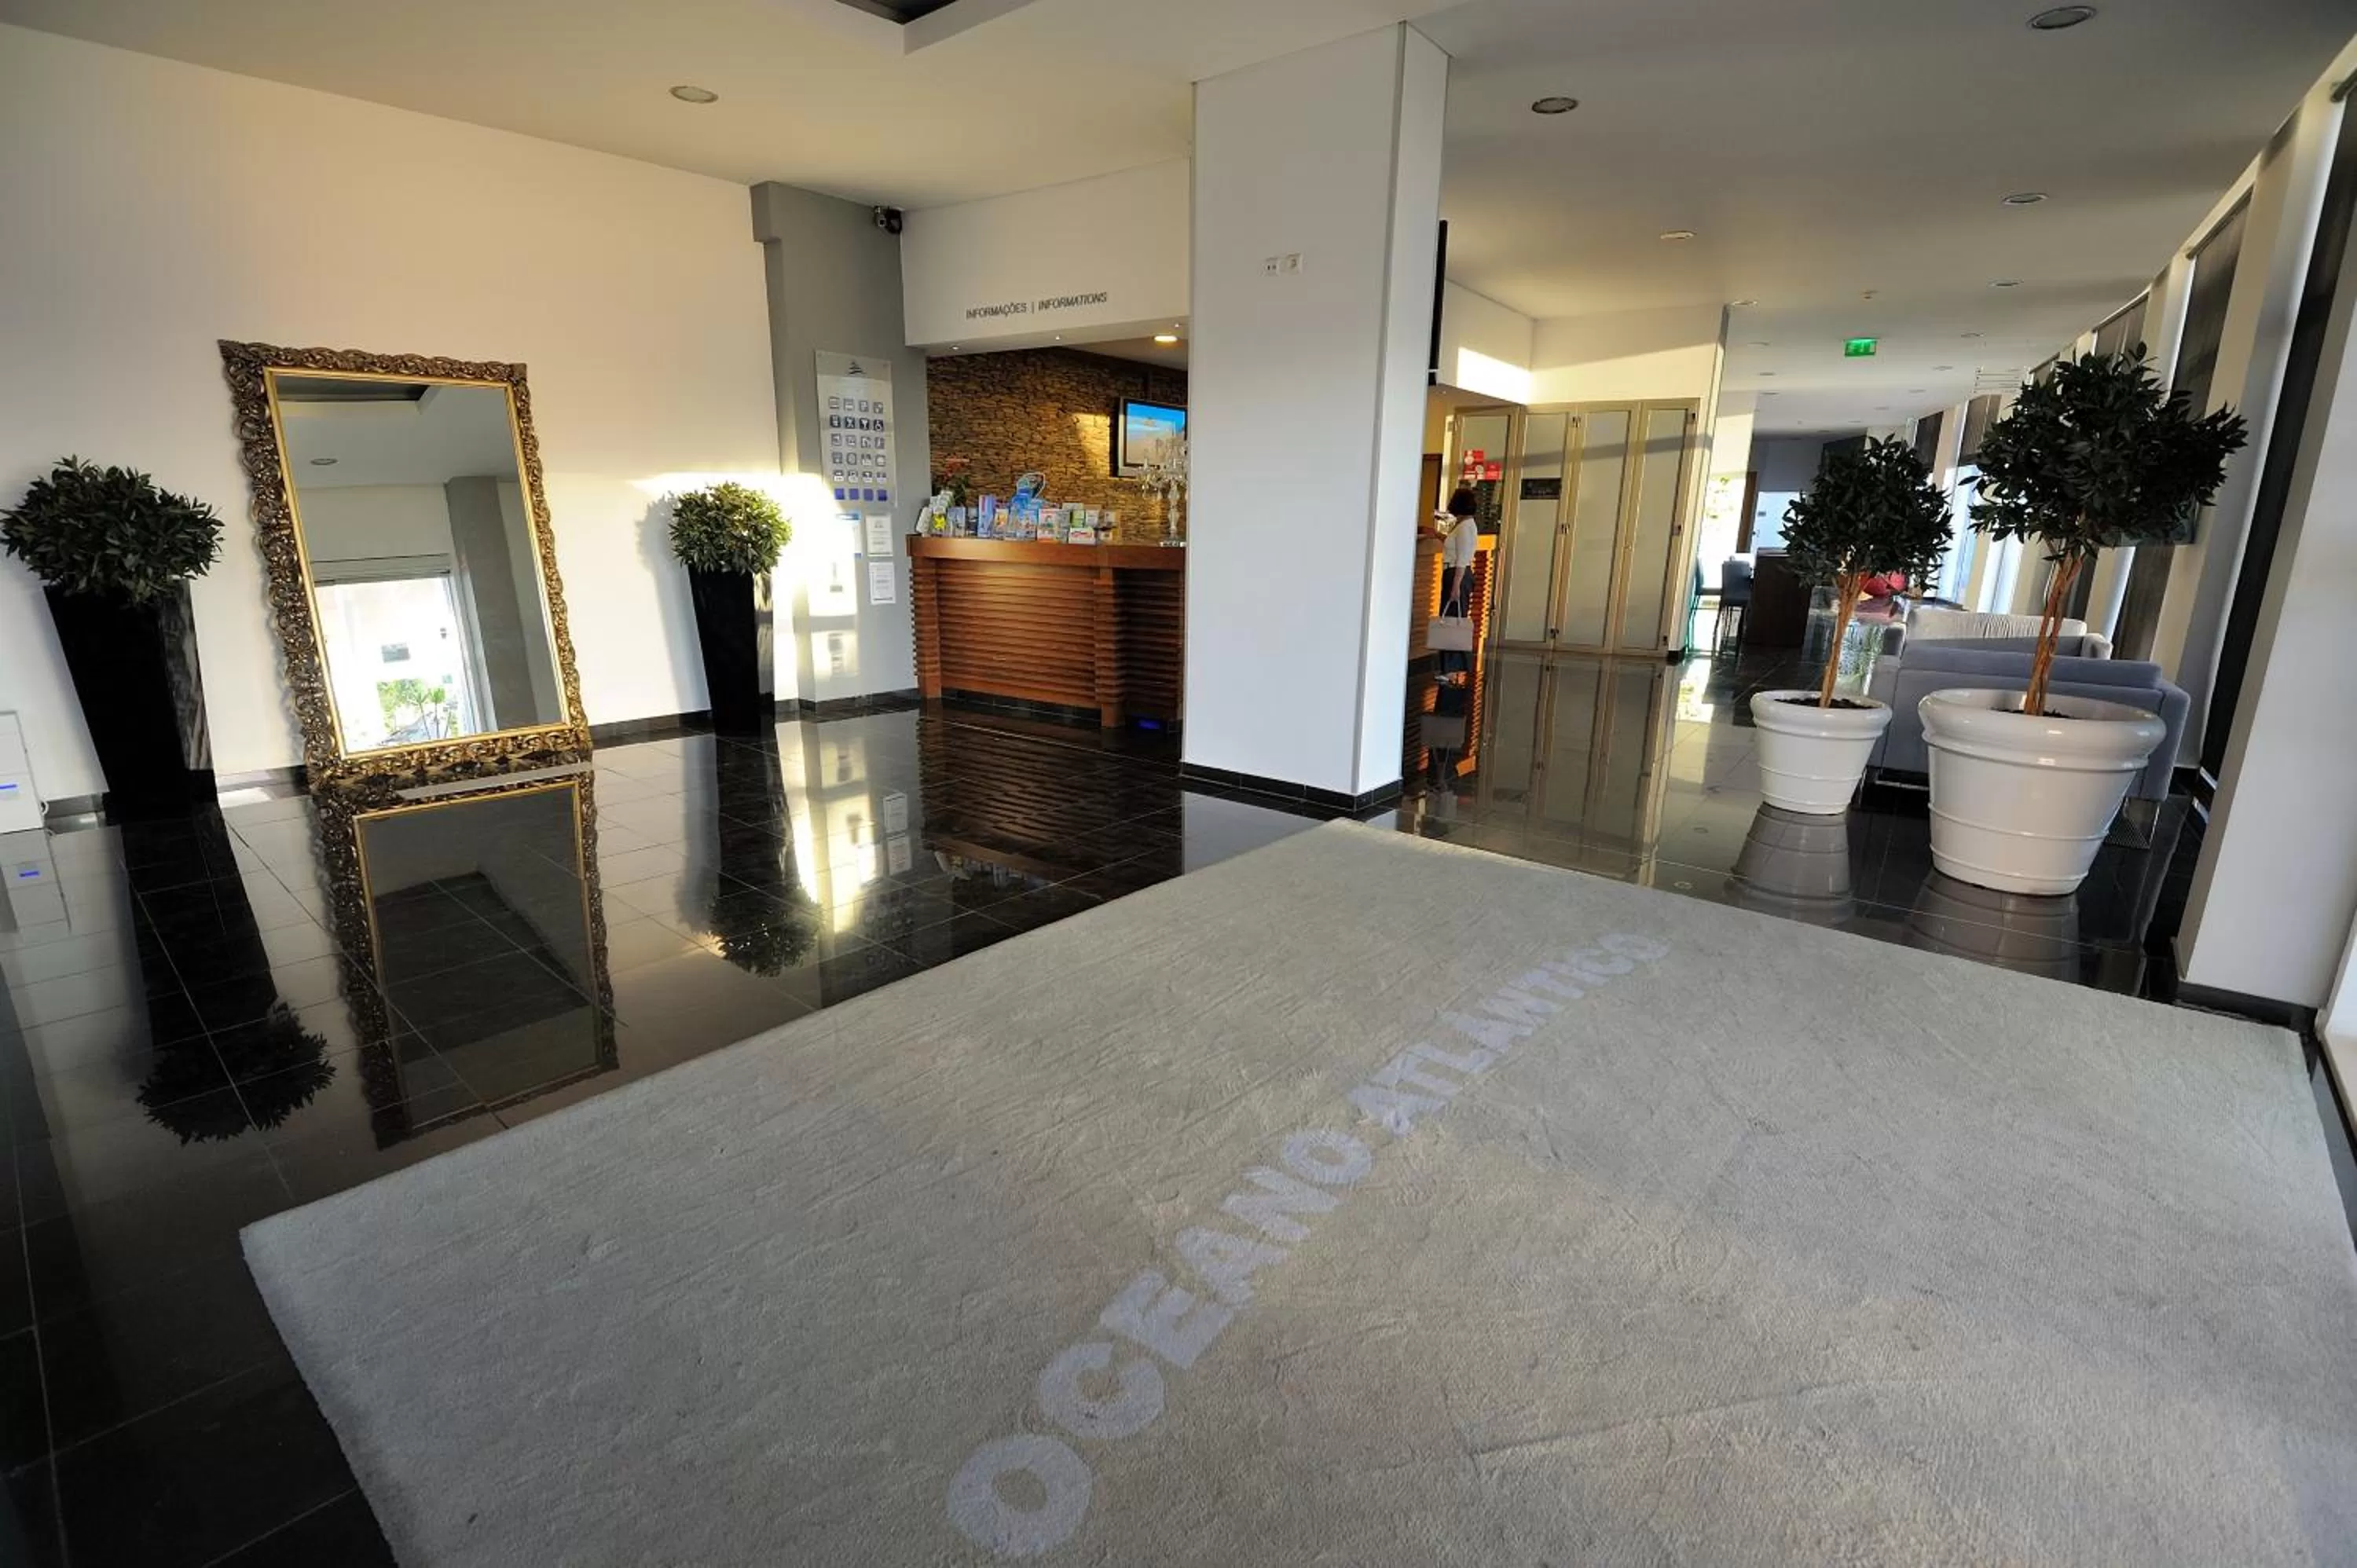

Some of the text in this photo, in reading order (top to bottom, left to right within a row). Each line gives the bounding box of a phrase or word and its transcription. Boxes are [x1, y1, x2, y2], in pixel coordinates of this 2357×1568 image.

[966, 302, 1027, 320] INFORMAÇÕES
[1038, 291, 1108, 311] INFORMATIONS
[946, 932, 1672, 1557] OCEANO ATLANTICO
